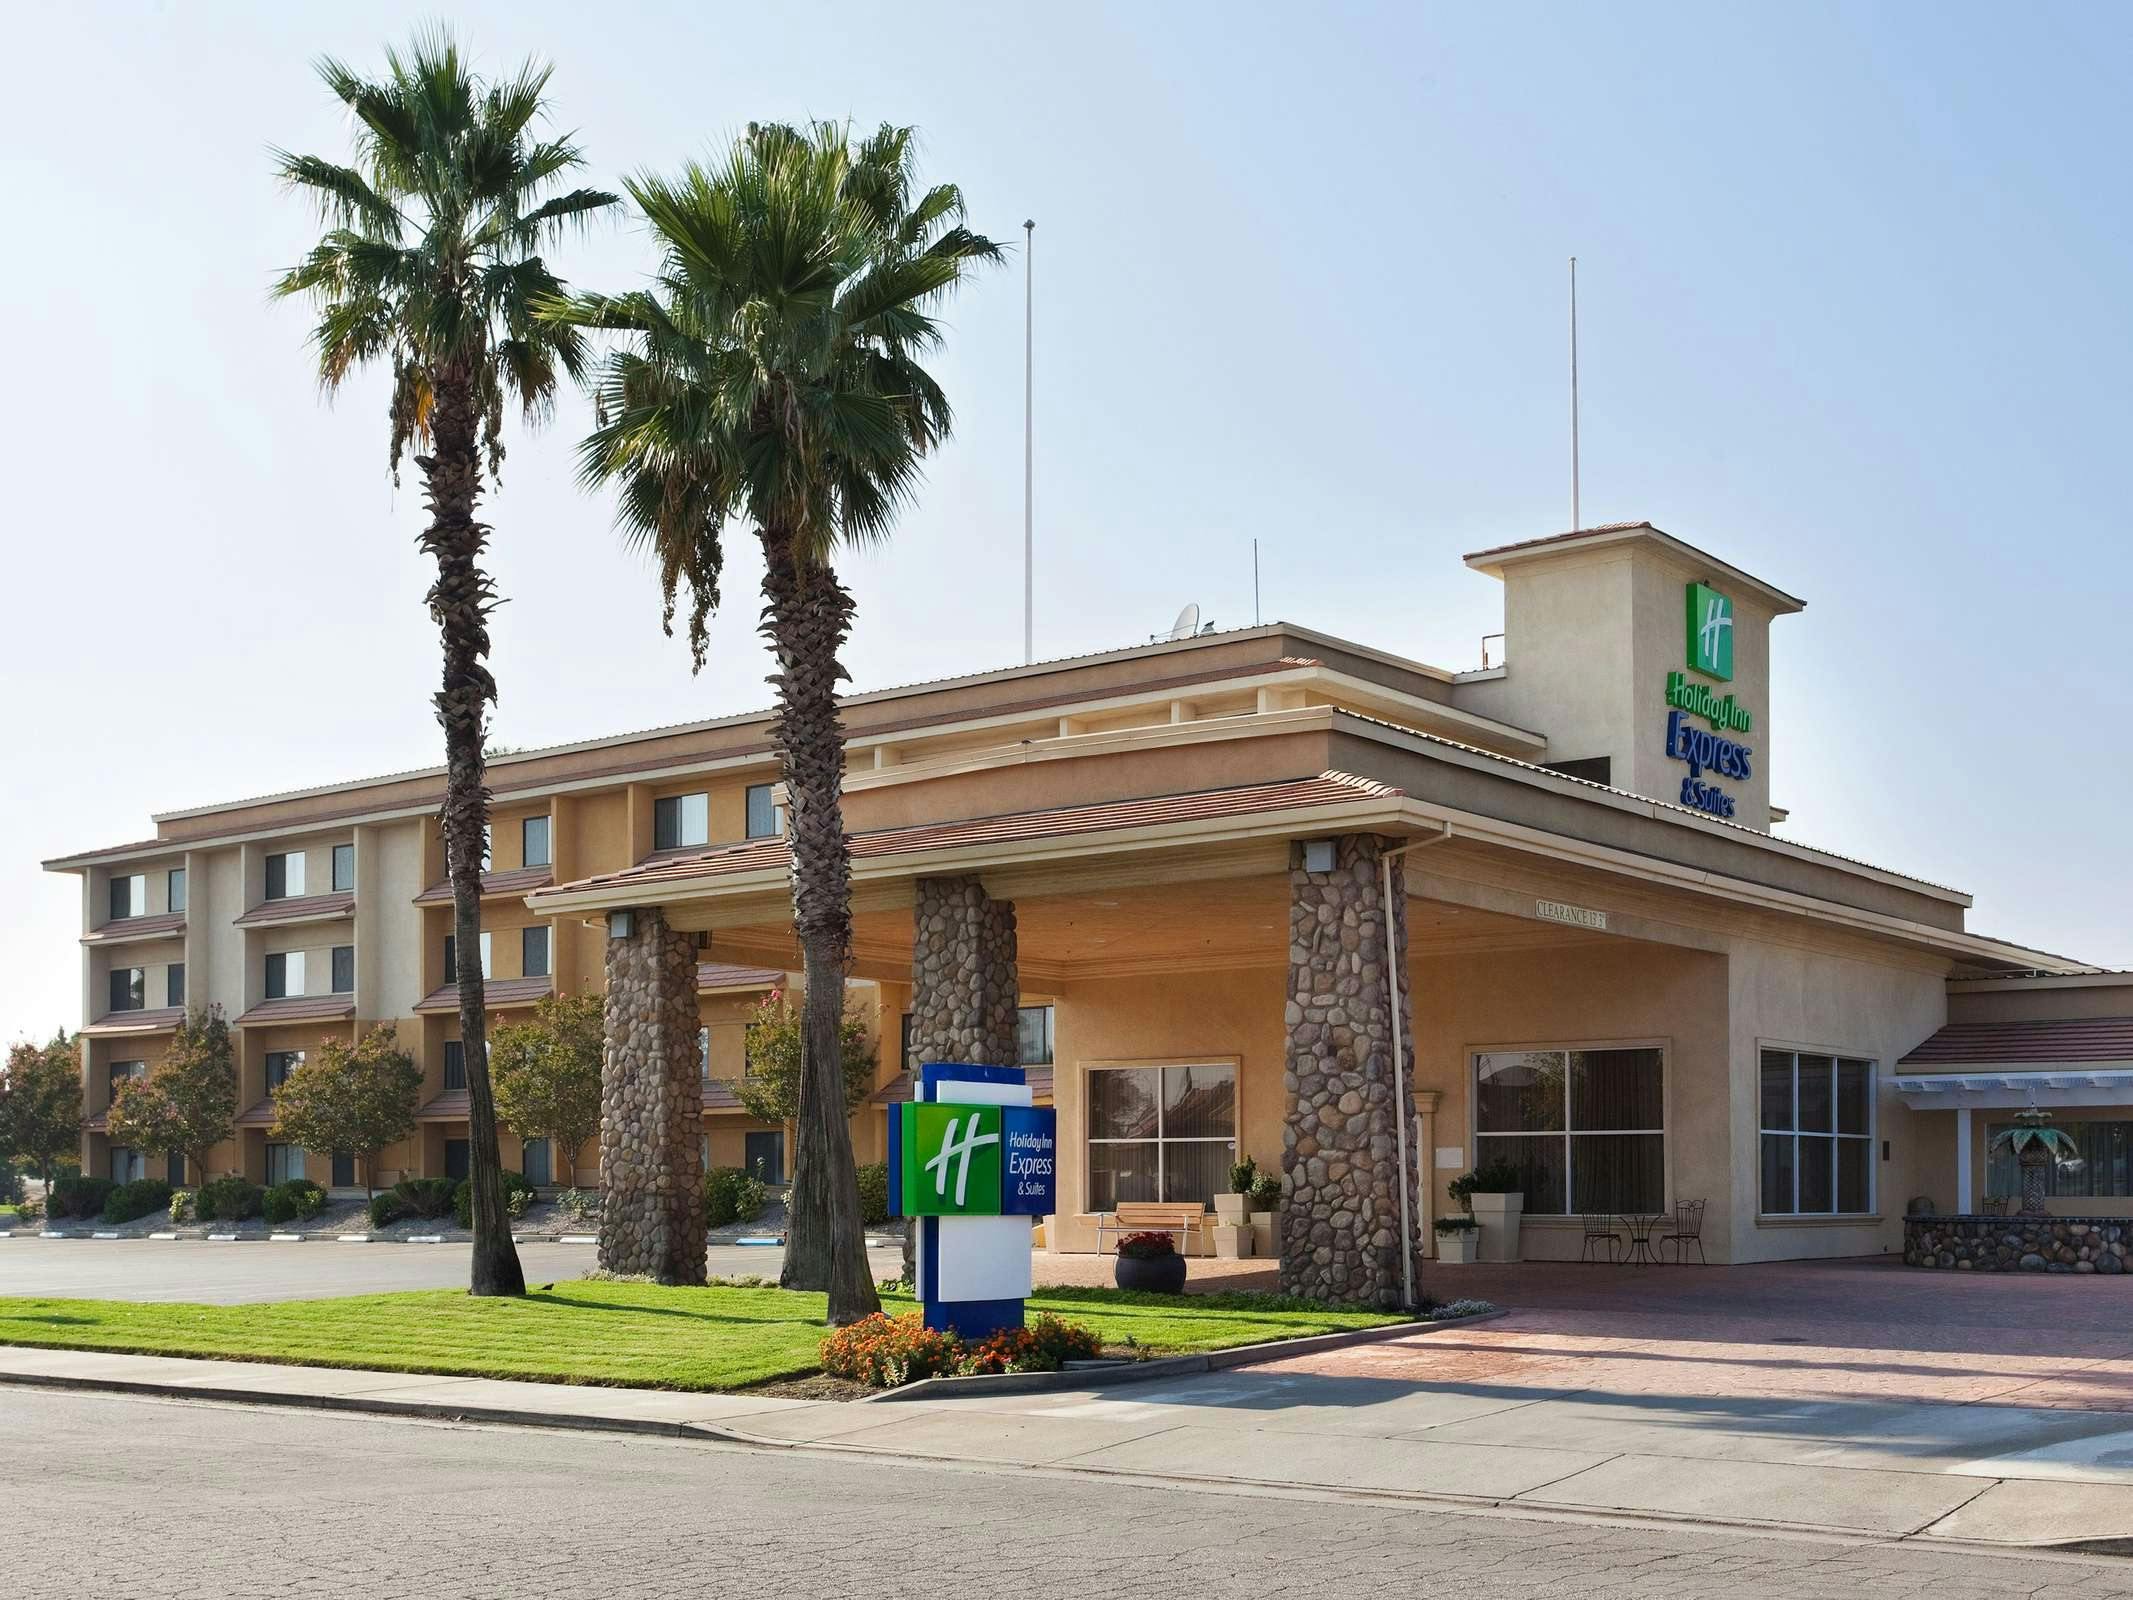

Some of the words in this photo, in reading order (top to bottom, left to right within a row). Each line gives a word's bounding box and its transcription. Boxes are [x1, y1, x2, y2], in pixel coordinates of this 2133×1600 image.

[1667, 672, 1729, 731] Holiday
[1726, 695, 1752, 732] Inn
[1666, 711, 1752, 780] Express
[1681, 778, 1696, 806] &
[1694, 781, 1736, 817] Suites
[1537, 901, 1588, 924] CLEARANCE
[1009, 1131, 1042, 1152] Holiday
[1041, 1133, 1053, 1149] Inn
[1009, 1152, 1053, 1180] Express
[1017, 1181, 1025, 1196] &
[1025, 1181, 1046, 1196] Suites
